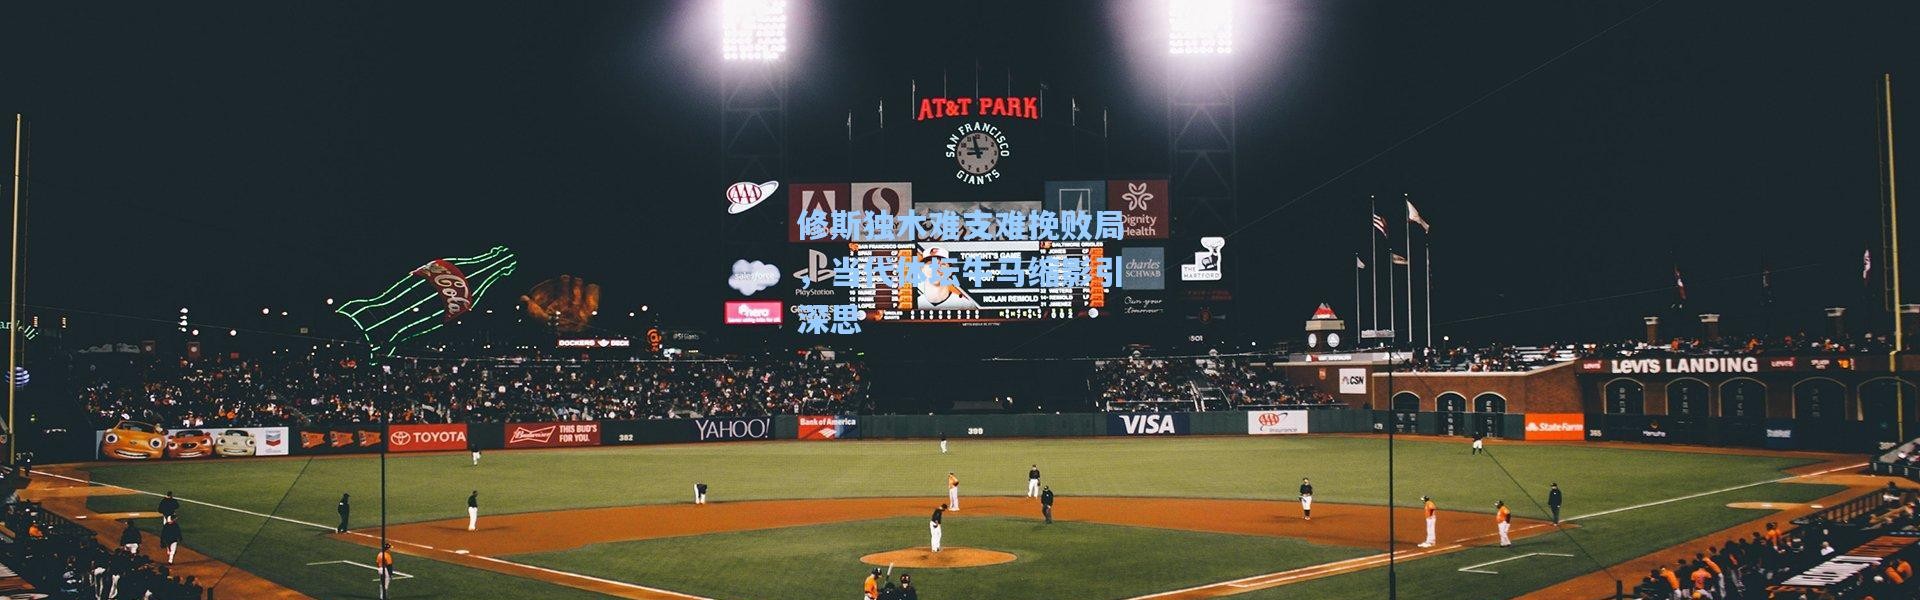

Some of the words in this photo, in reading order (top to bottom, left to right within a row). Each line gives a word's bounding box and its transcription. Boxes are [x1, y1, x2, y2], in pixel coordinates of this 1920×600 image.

[918, 97, 972, 120] AT&T
[980, 97, 1038, 120] PARK
[946, 134, 960, 158] SAN
[958, 121, 1010, 157] FRANCISCO
[956, 169, 1000, 185] GIANTS
[729, 183, 762, 204] AAA
[1122, 214, 1156, 228] Dignity
[1122, 226, 1156, 236] Health
[1126, 259, 1160, 270] charles
[435, 274, 471, 312] Cola
[796, 289, 835, 297] PlayStation
[1666, 357, 1758, 372] LANDING
[1350, 376, 1363, 385] CSN
[800, 418, 818, 426] Bank
[819, 418, 826, 426] of
[826, 418, 856, 426] America
[1119, 414, 1175, 434] VISA
[1259, 413, 1280, 426] AAA
[515, 430, 550, 440] Budweiser
[696, 418, 770, 440] YAHOO!
[413, 431, 466, 442] TOYOTA
